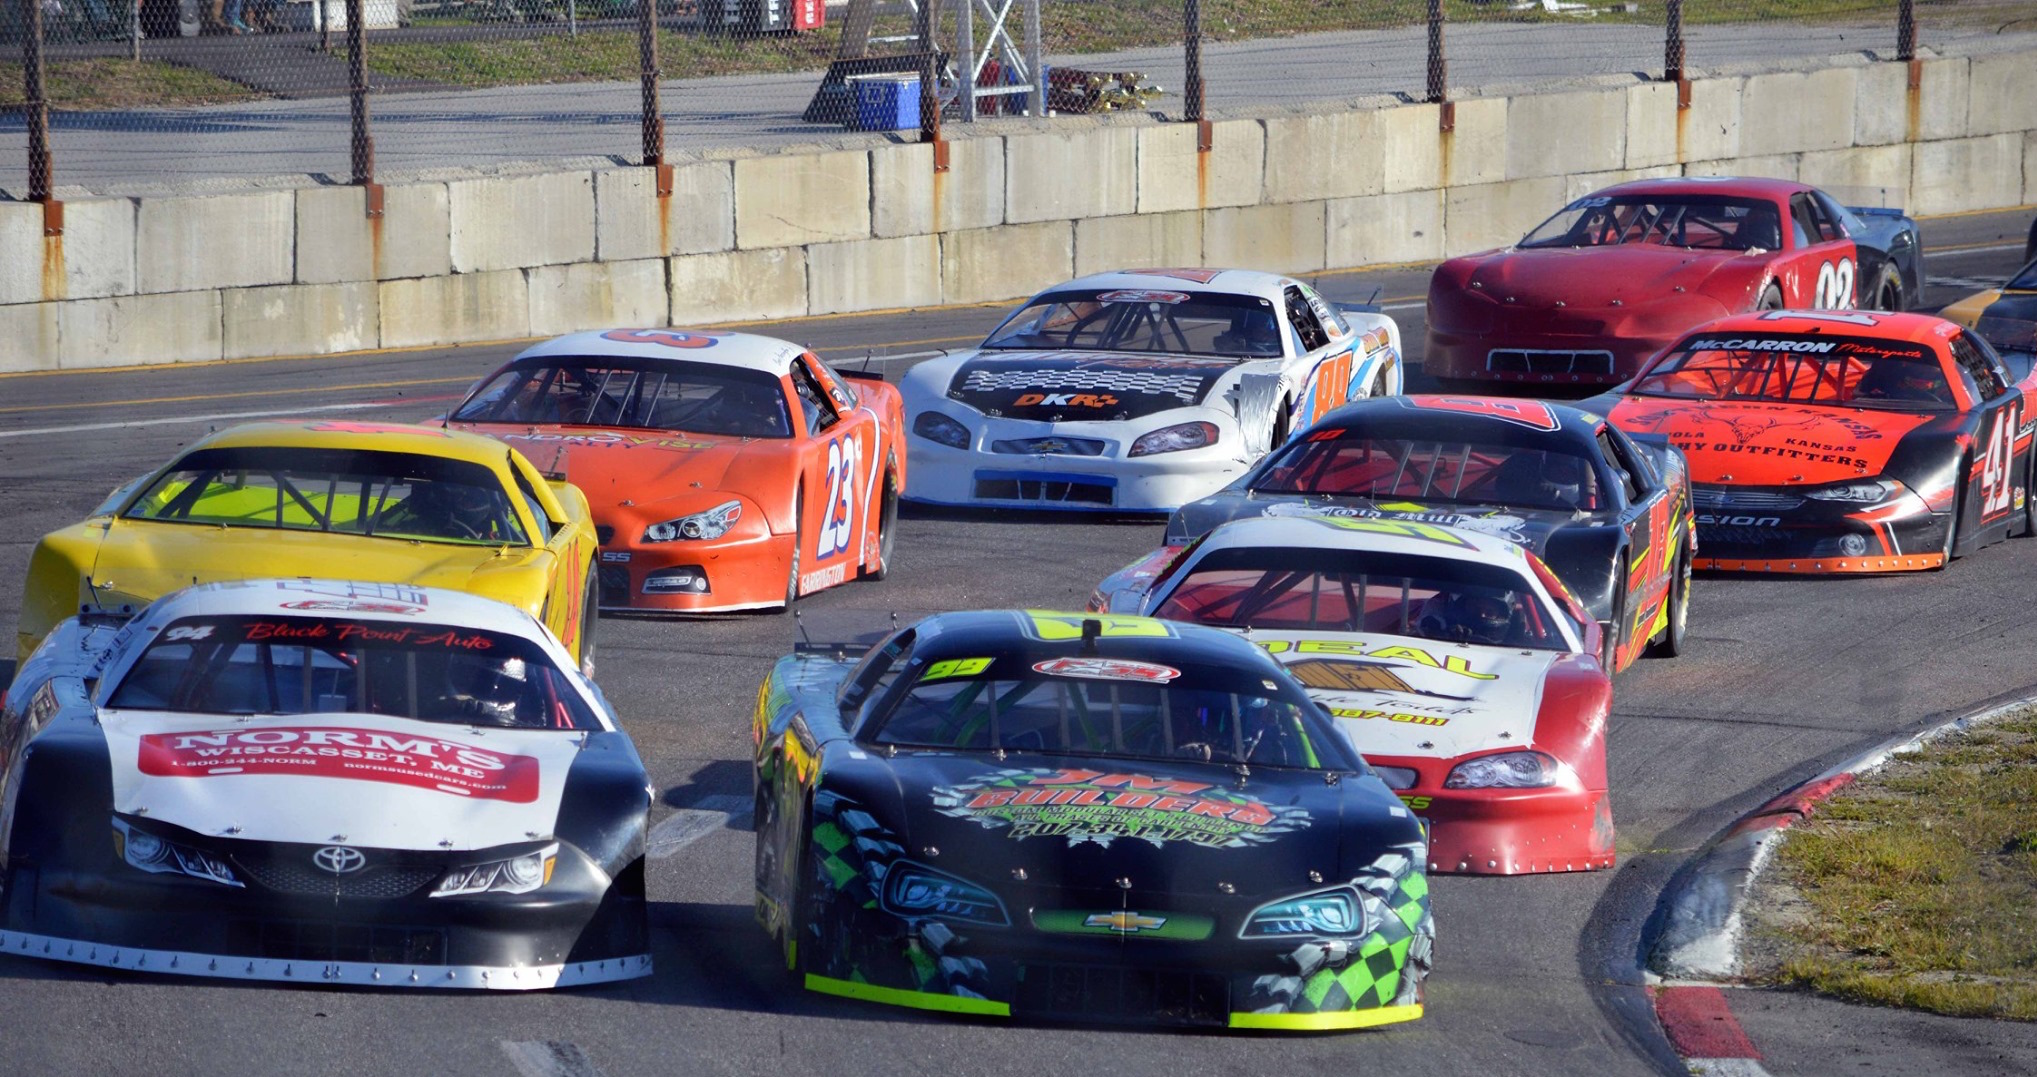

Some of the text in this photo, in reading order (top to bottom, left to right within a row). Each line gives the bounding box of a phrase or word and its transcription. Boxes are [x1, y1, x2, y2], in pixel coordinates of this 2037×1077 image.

[1690, 339, 1836, 352] McCARRON
[1714, 444, 1868, 469] OUTFITTERS
[1785, 438, 1857, 453] KANSAS
[1980, 400, 2017, 525] 41
[815, 433, 855, 561] 23
[603, 552, 631, 562] SS
[242, 622, 496, 651] Black Point Auto
[919, 656, 996, 682] 99
[174, 730, 505, 771] NORM'S
[195, 746, 485, 779] WISCASSET, ME
[171, 758, 508, 790] 1-800-244-NORM normsusedcars.com
[965, 788, 1277, 826] BUILDERS
